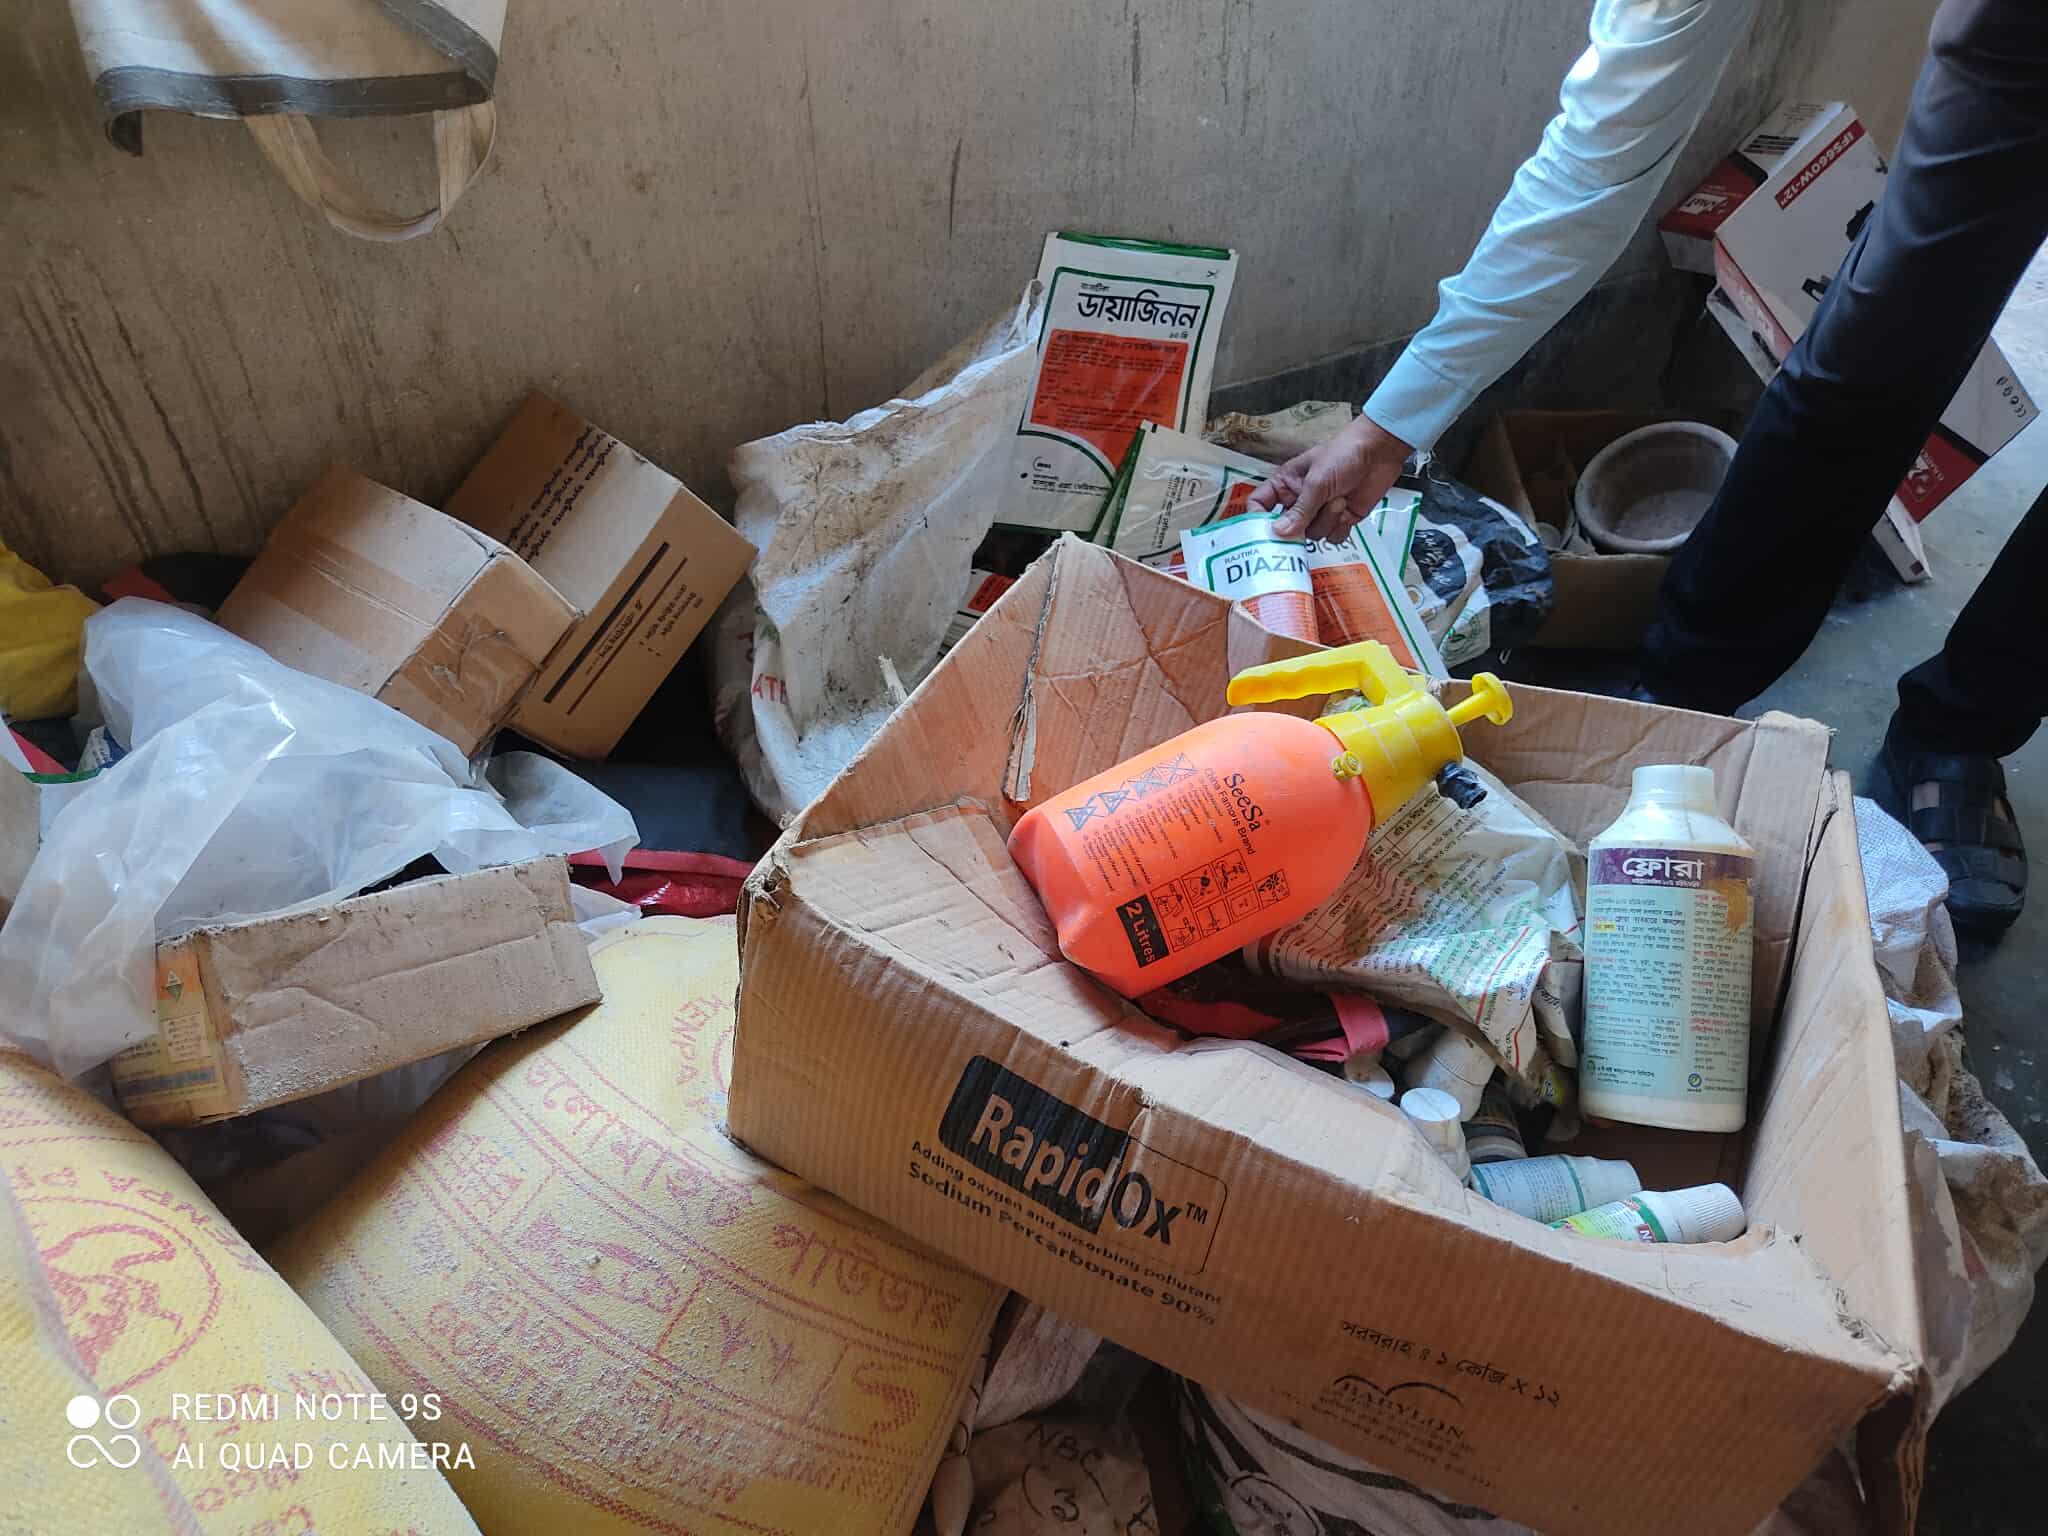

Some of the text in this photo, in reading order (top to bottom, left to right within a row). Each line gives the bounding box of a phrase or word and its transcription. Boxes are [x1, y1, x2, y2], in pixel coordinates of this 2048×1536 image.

[1077, 289, 1200, 328] ডায়াজিনন
[1216, 789, 1243, 826] Famous
[1222, 771, 1263, 833] SeeSa
[1622, 856, 1704, 880] ফ্লোরা
[1125, 900, 1159, 962] 2 Litres
[912, 1141, 965, 1182] Adding
[967, 1176, 1023, 1213] oxygen
[1026, 1205, 1055, 1230] and
[908, 1161, 1216, 1326] Sodium Percarbonate 90%
